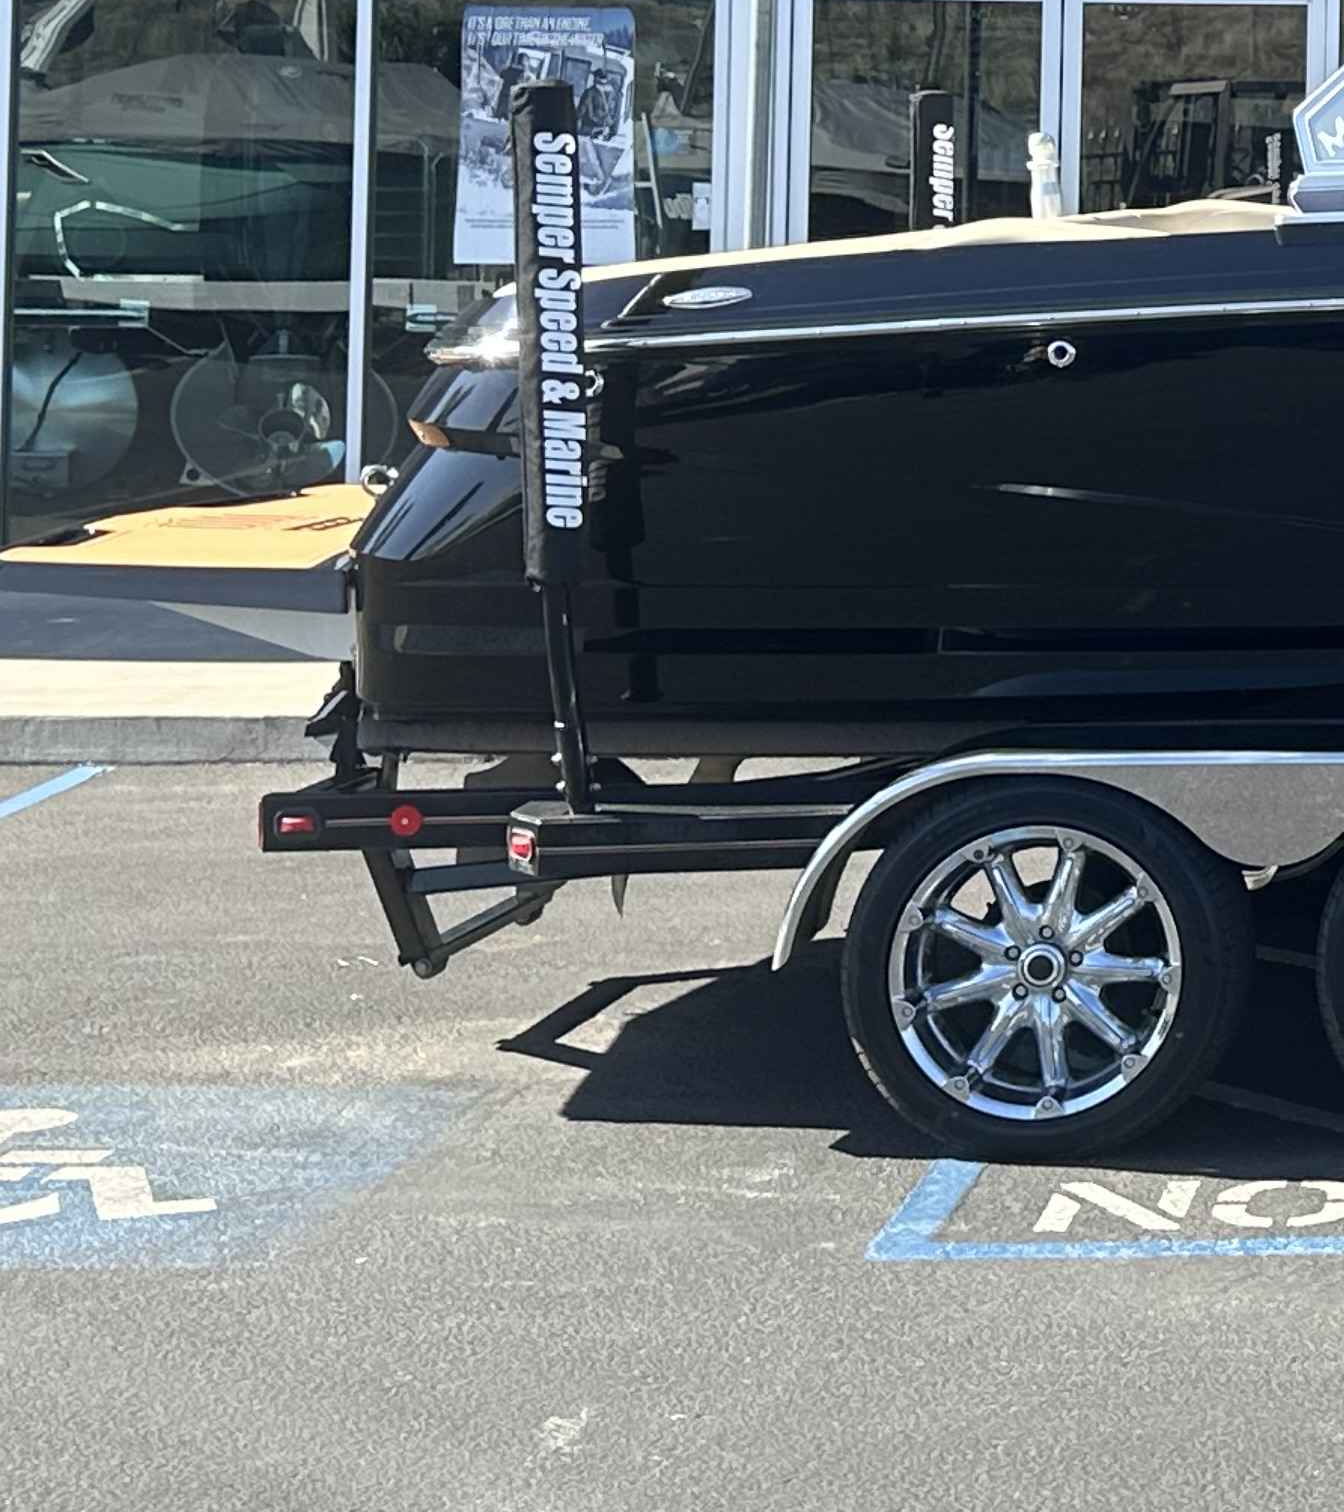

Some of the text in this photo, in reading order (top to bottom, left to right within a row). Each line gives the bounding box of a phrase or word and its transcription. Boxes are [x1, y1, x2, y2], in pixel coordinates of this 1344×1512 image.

[929, 123, 955, 223] Semper
[532, 132, 588, 530] Semper Speed & Marine
